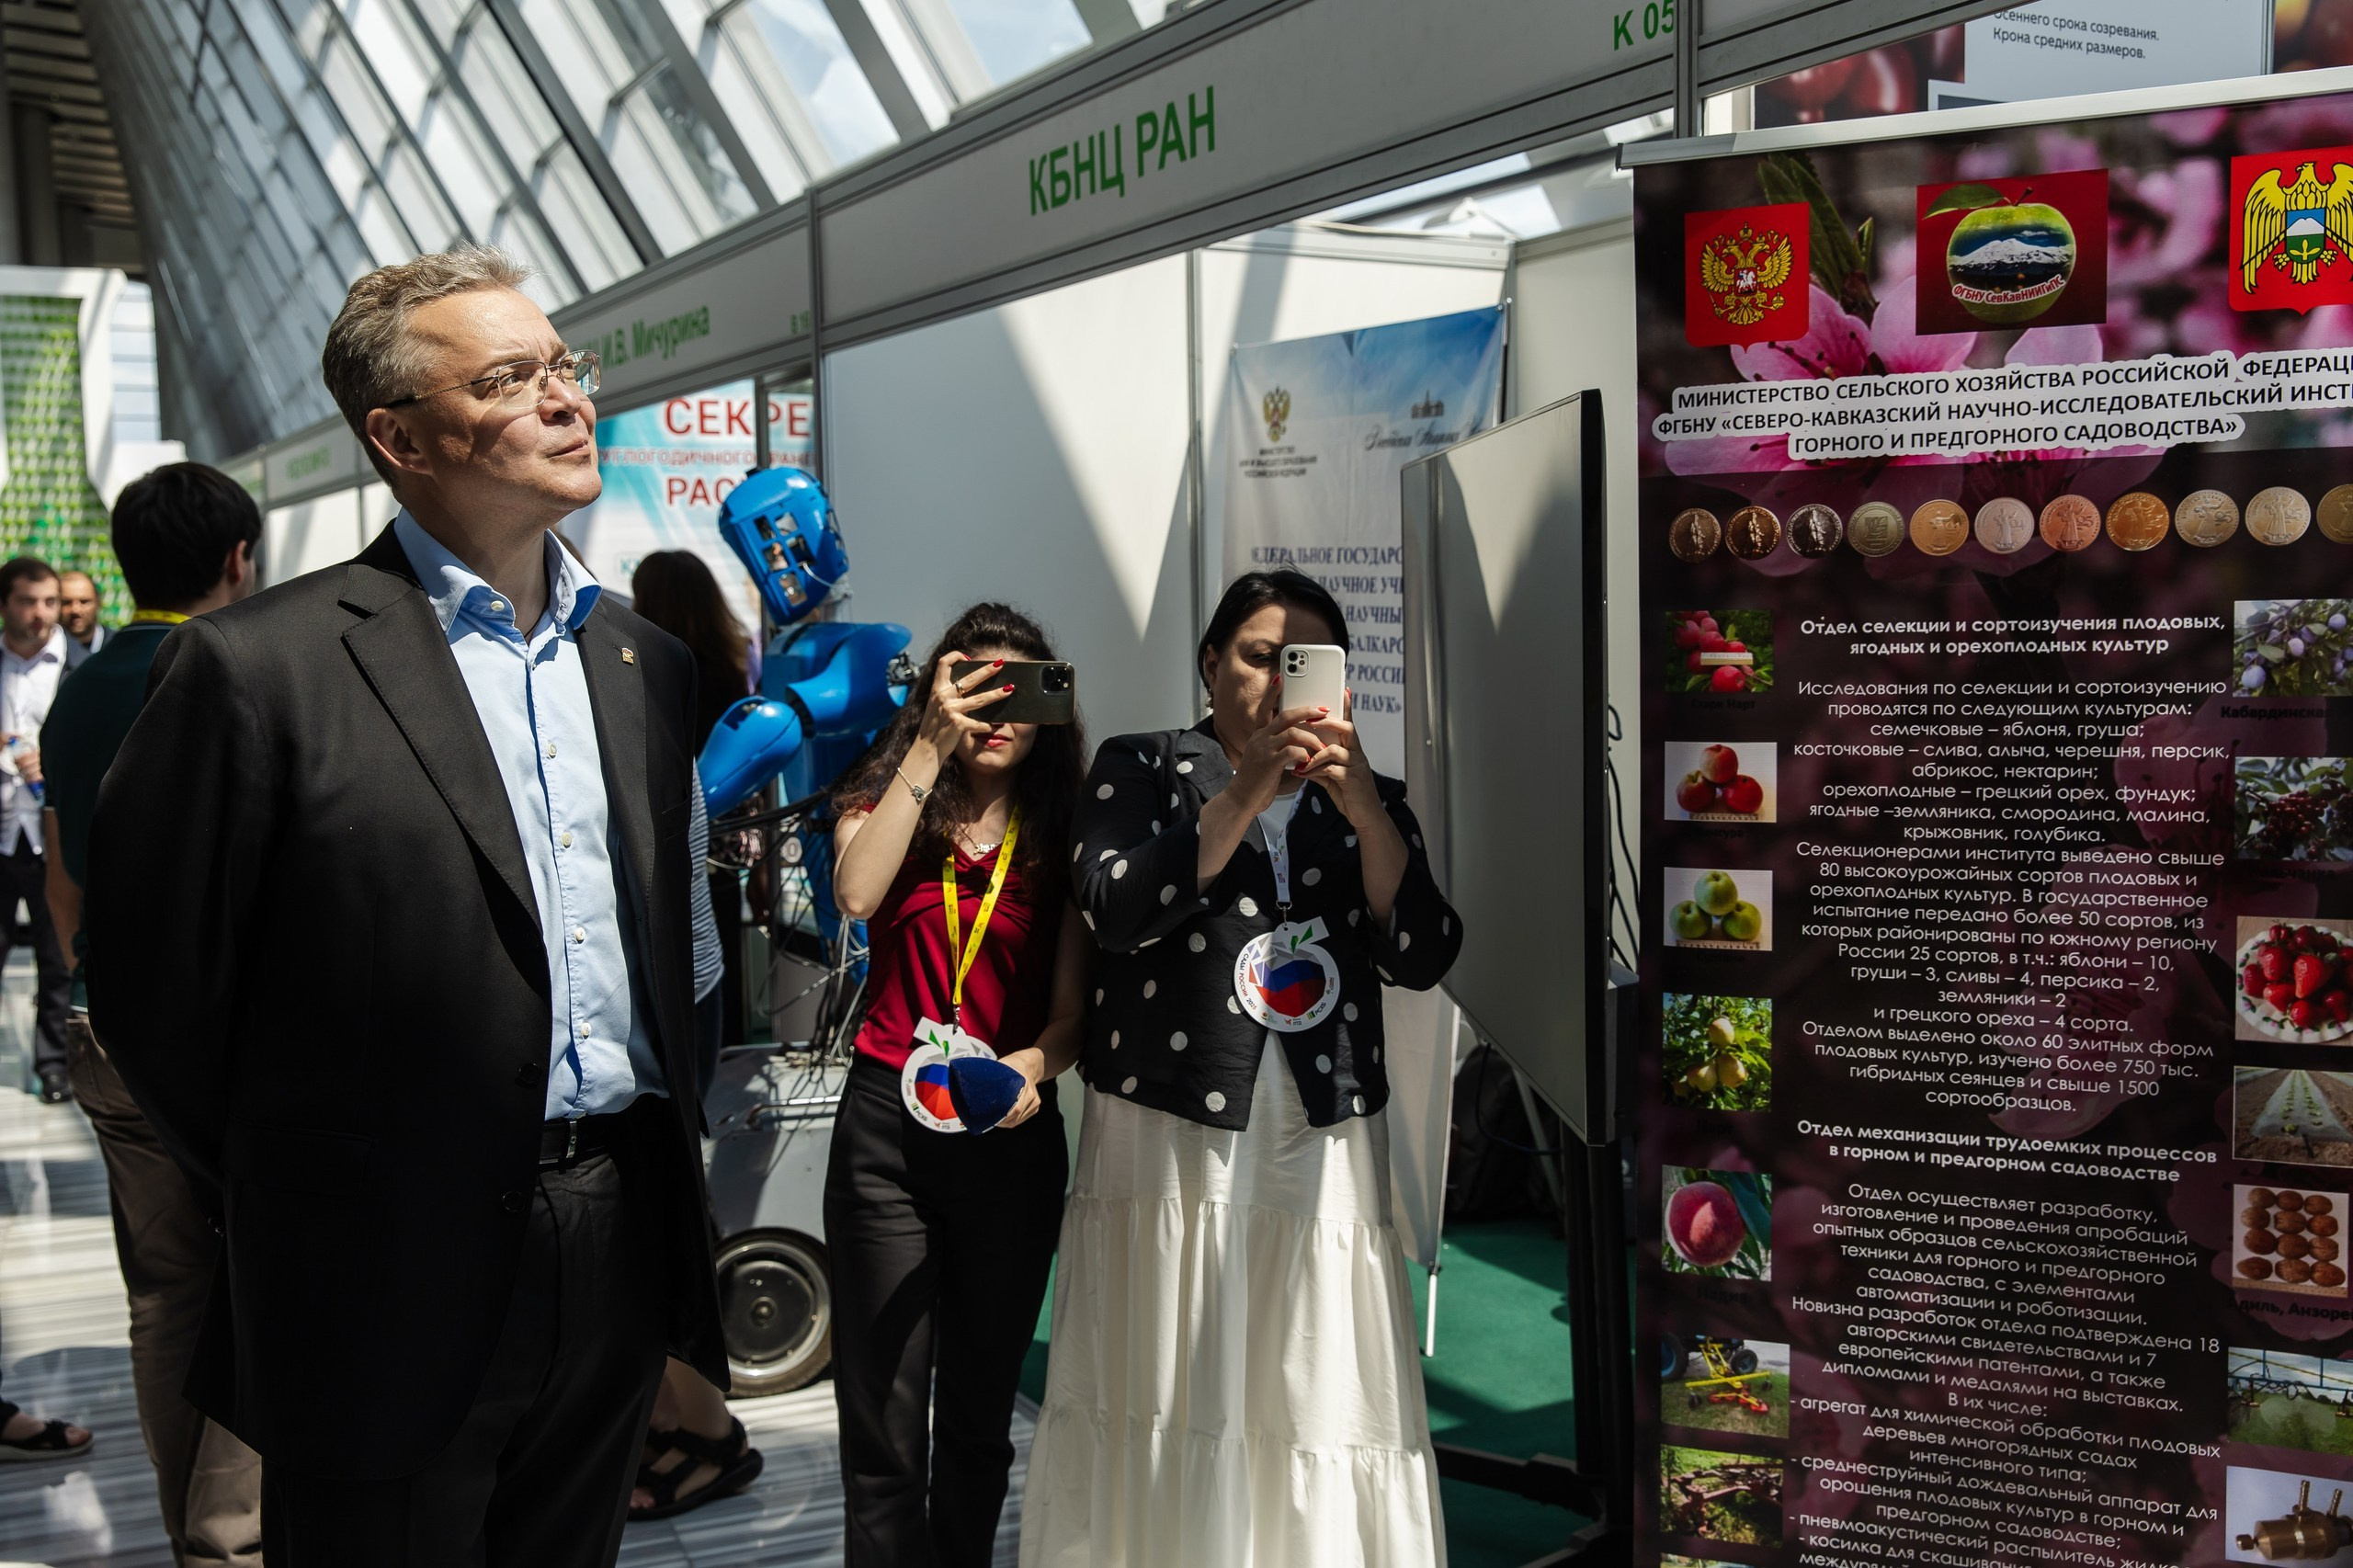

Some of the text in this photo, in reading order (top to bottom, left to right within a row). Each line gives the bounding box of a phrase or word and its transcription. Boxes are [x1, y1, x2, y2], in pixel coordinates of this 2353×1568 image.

[1643, 0, 1674, 40] 05
[2052, 17, 2087, 31] срока
[2089, 22, 2159, 40] созревания.
[1993, 27, 2146, 60] Крона средних размеров.
[1029, 85, 1215, 216] КБНЦ РАН
[1953, 285, 1984, 301] ФГБНУ
[631, 305, 710, 360] Мичурина
[1678, 355, 2353, 409] МИНИСТЕРСТВО СЕЛЬСКОГО ХОЗЯЙСТВА РОССИЙСКОЙ ФЕДЕРАЦ
[1658, 383, 2353, 435] ФГБНУ «СЕВЕРО-КАВКАЗСКИЙ НАУЧНО-ИССЛЕДОВАТЕЛЬСКИЙ ИНСТ
[1795, 418, 2237, 453] ГОРНОГО И ПРЕДГОРНОГО САДОВОДСТВА»
[667, 477, 741, 506] РАС
[1346, 606, 1402, 624] НАУЧНЫ
[1801, 616, 2225, 636] Отдел селекции и сортоизучения плодовых,
[1849, 639, 2169, 657] ягодных и орехоплодных культур
[1798, 681, 2227, 698] Исследования по селекции и сортоизучению
[1828, 703, 2192, 719] проводятся по следующим культурам:
[1870, 721, 2144, 740] семечковые яблоня, груша;
[1794, 744, 2230, 762] косточковые слива, алыча, черешня, персик,
[1823, 784, 2196, 804] орехоплодные грецкий орех, фундук;
[1809, 804, 1880, 817] ягодные
[2001, 808, 2120, 824] смородина,
[2126, 810, 2211, 824] малина,
[1904, 826, 2106, 844] крыжовник, голубика.
[1796, 841, 2225, 866] Селекционерами института выведено свыше
[1810, 884, 2209, 909] орехоплодных культур. В государственное
[1802, 925, 2218, 954] которых районированы по южному региону
[1802, 1020, 2213, 1059] Отделом выделено около 60 элитных форм
[1814, 1044, 2199, 1077] плодовых культур, изучено более 750 тыс.
[1925, 1091, 2076, 1112] сортообразцов.
[1797, 1119, 2217, 1164] Отдел механизации трудоемких процессов
[1829, 1145, 2180, 1182] в горном и предгорном садоводстве
[1821, 1204, 2188, 1245] изготовление и проведения апробаций
[1813, 1222, 2197, 1267] опытных образцов сельскохозяйственной
[1868, 1267, 2134, 1303] садоводства, с элементами
[1792, 1296, 2220, 1354] Новизна разработок отдела подтверждена 18
[2289, 1302, 2353, 1323] Анзоре
[1800, 1397, 2221, 1459] агрегат для химической обработки плодовых
[1801, 1456, 2218, 1520] среднеструйный дождевальный аппарат для
[1799, 1514, 2115, 1568] пневмоакустический распылитель
[1876, 1505, 2121, 1550] предгорном садоводстве;
[1808, 1534, 1915, 1560] косилка для
